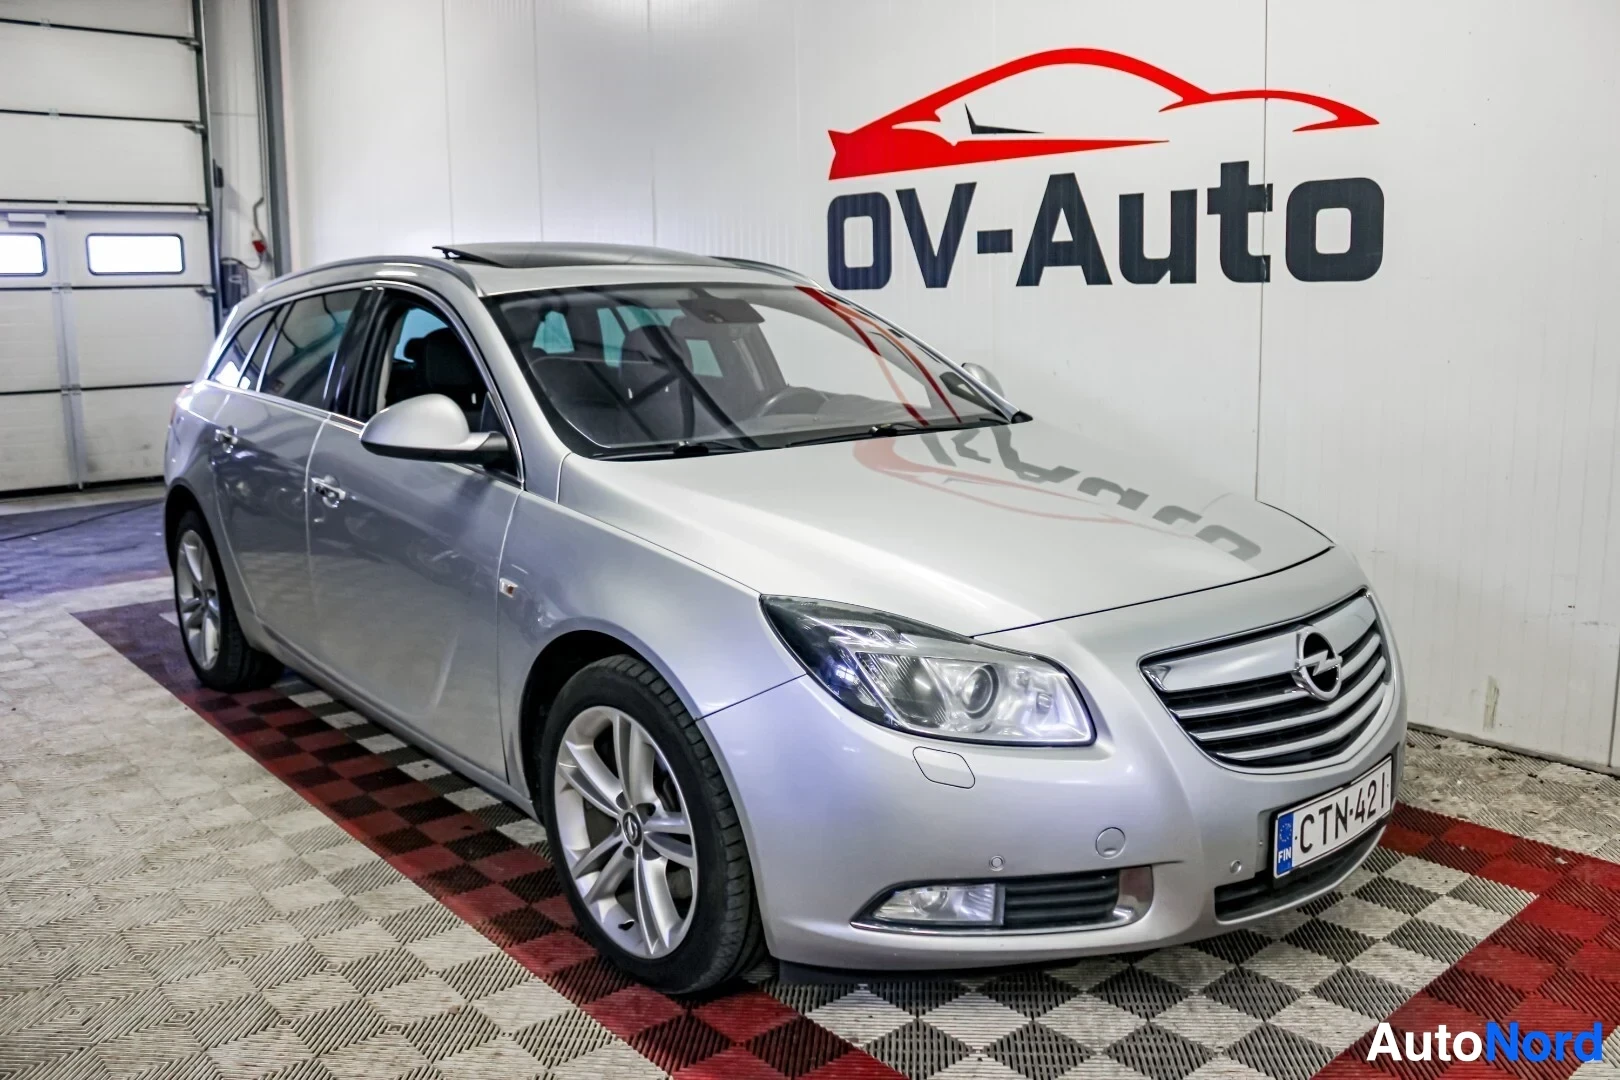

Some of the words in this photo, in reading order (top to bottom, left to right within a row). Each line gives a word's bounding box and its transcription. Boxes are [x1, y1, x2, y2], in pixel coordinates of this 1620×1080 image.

[827, 160, 1384, 290] OV-Auto
[1300, 772, 1385, 853] CTN-421
[1278, 847, 1292, 864] FIN
